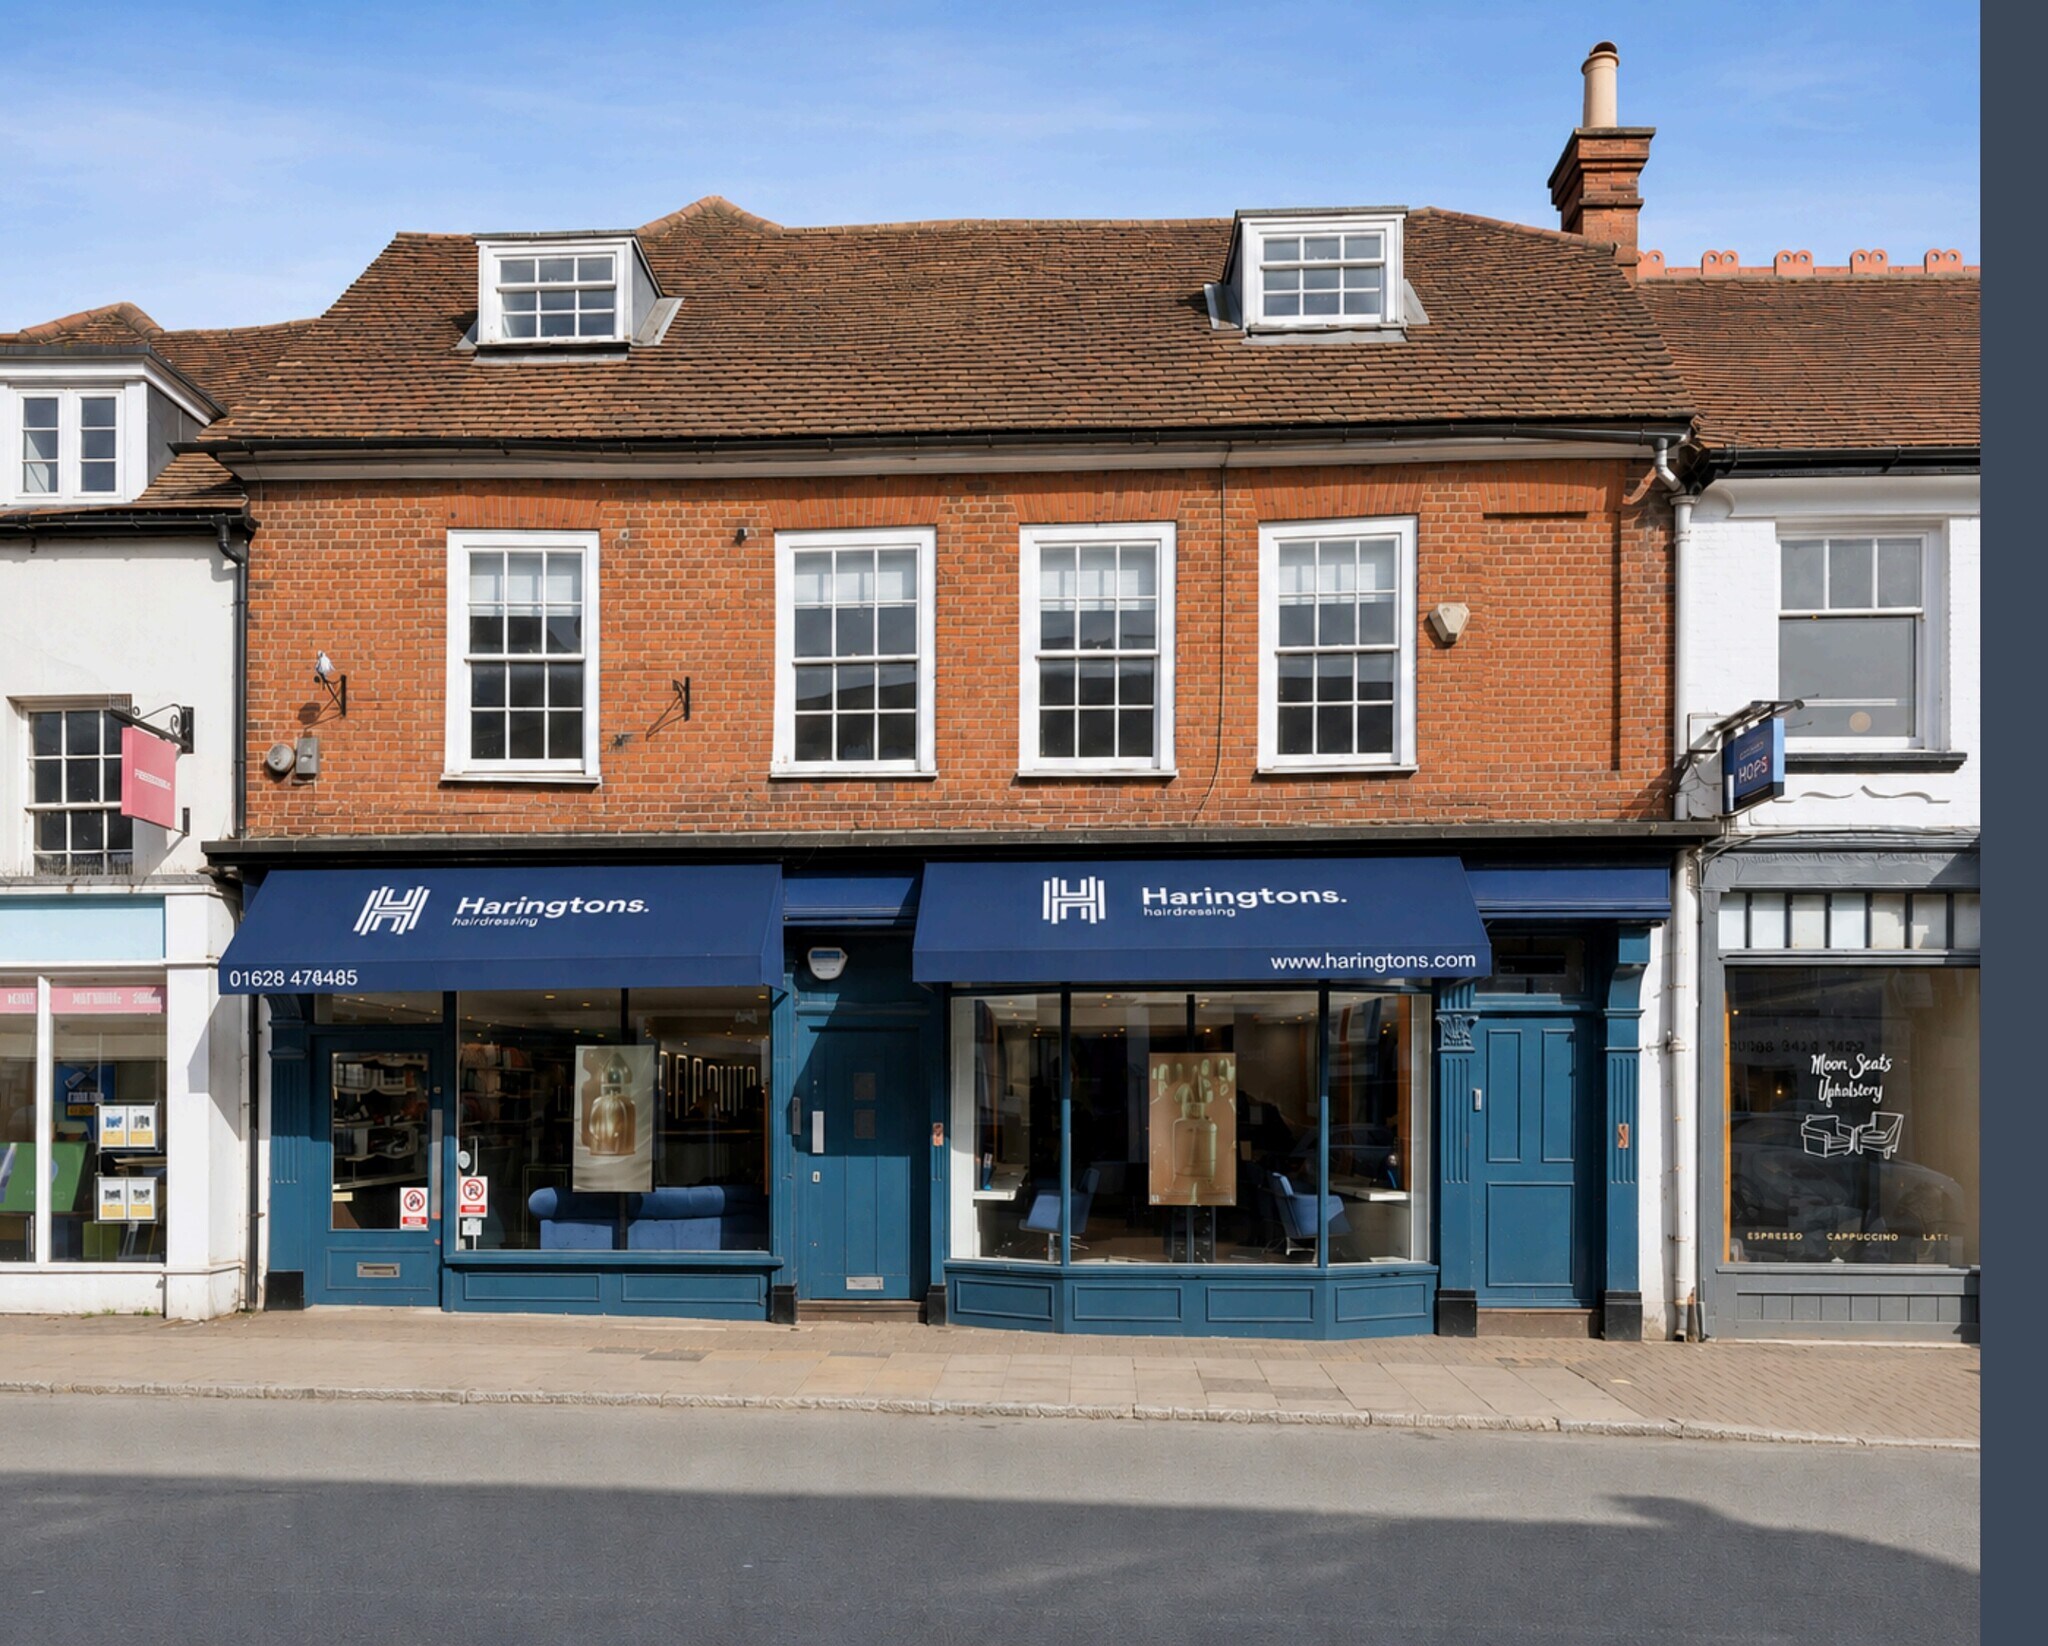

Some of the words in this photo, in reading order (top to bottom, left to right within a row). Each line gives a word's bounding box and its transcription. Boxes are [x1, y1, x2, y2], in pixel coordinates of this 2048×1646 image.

[456, 896, 650, 918] Haringtons.
[1142, 886, 1348, 909] Haringtons.
[451, 916, 539, 928] hairdressing
[1143, 907, 1236, 918] hairdressing
[1270, 952, 1477, 974] www.haringtons.com
[229, 970, 286, 988] 01628
[1811, 1053, 1848, 1077] Moon
[1849, 1053, 1892, 1079] Seats
[1818, 1078, 1883, 1108] Upholstery
[1747, 1231, 1803, 1241] ESPRESSO
[1826, 1232, 1899, 1241] CAPPUCCINO
